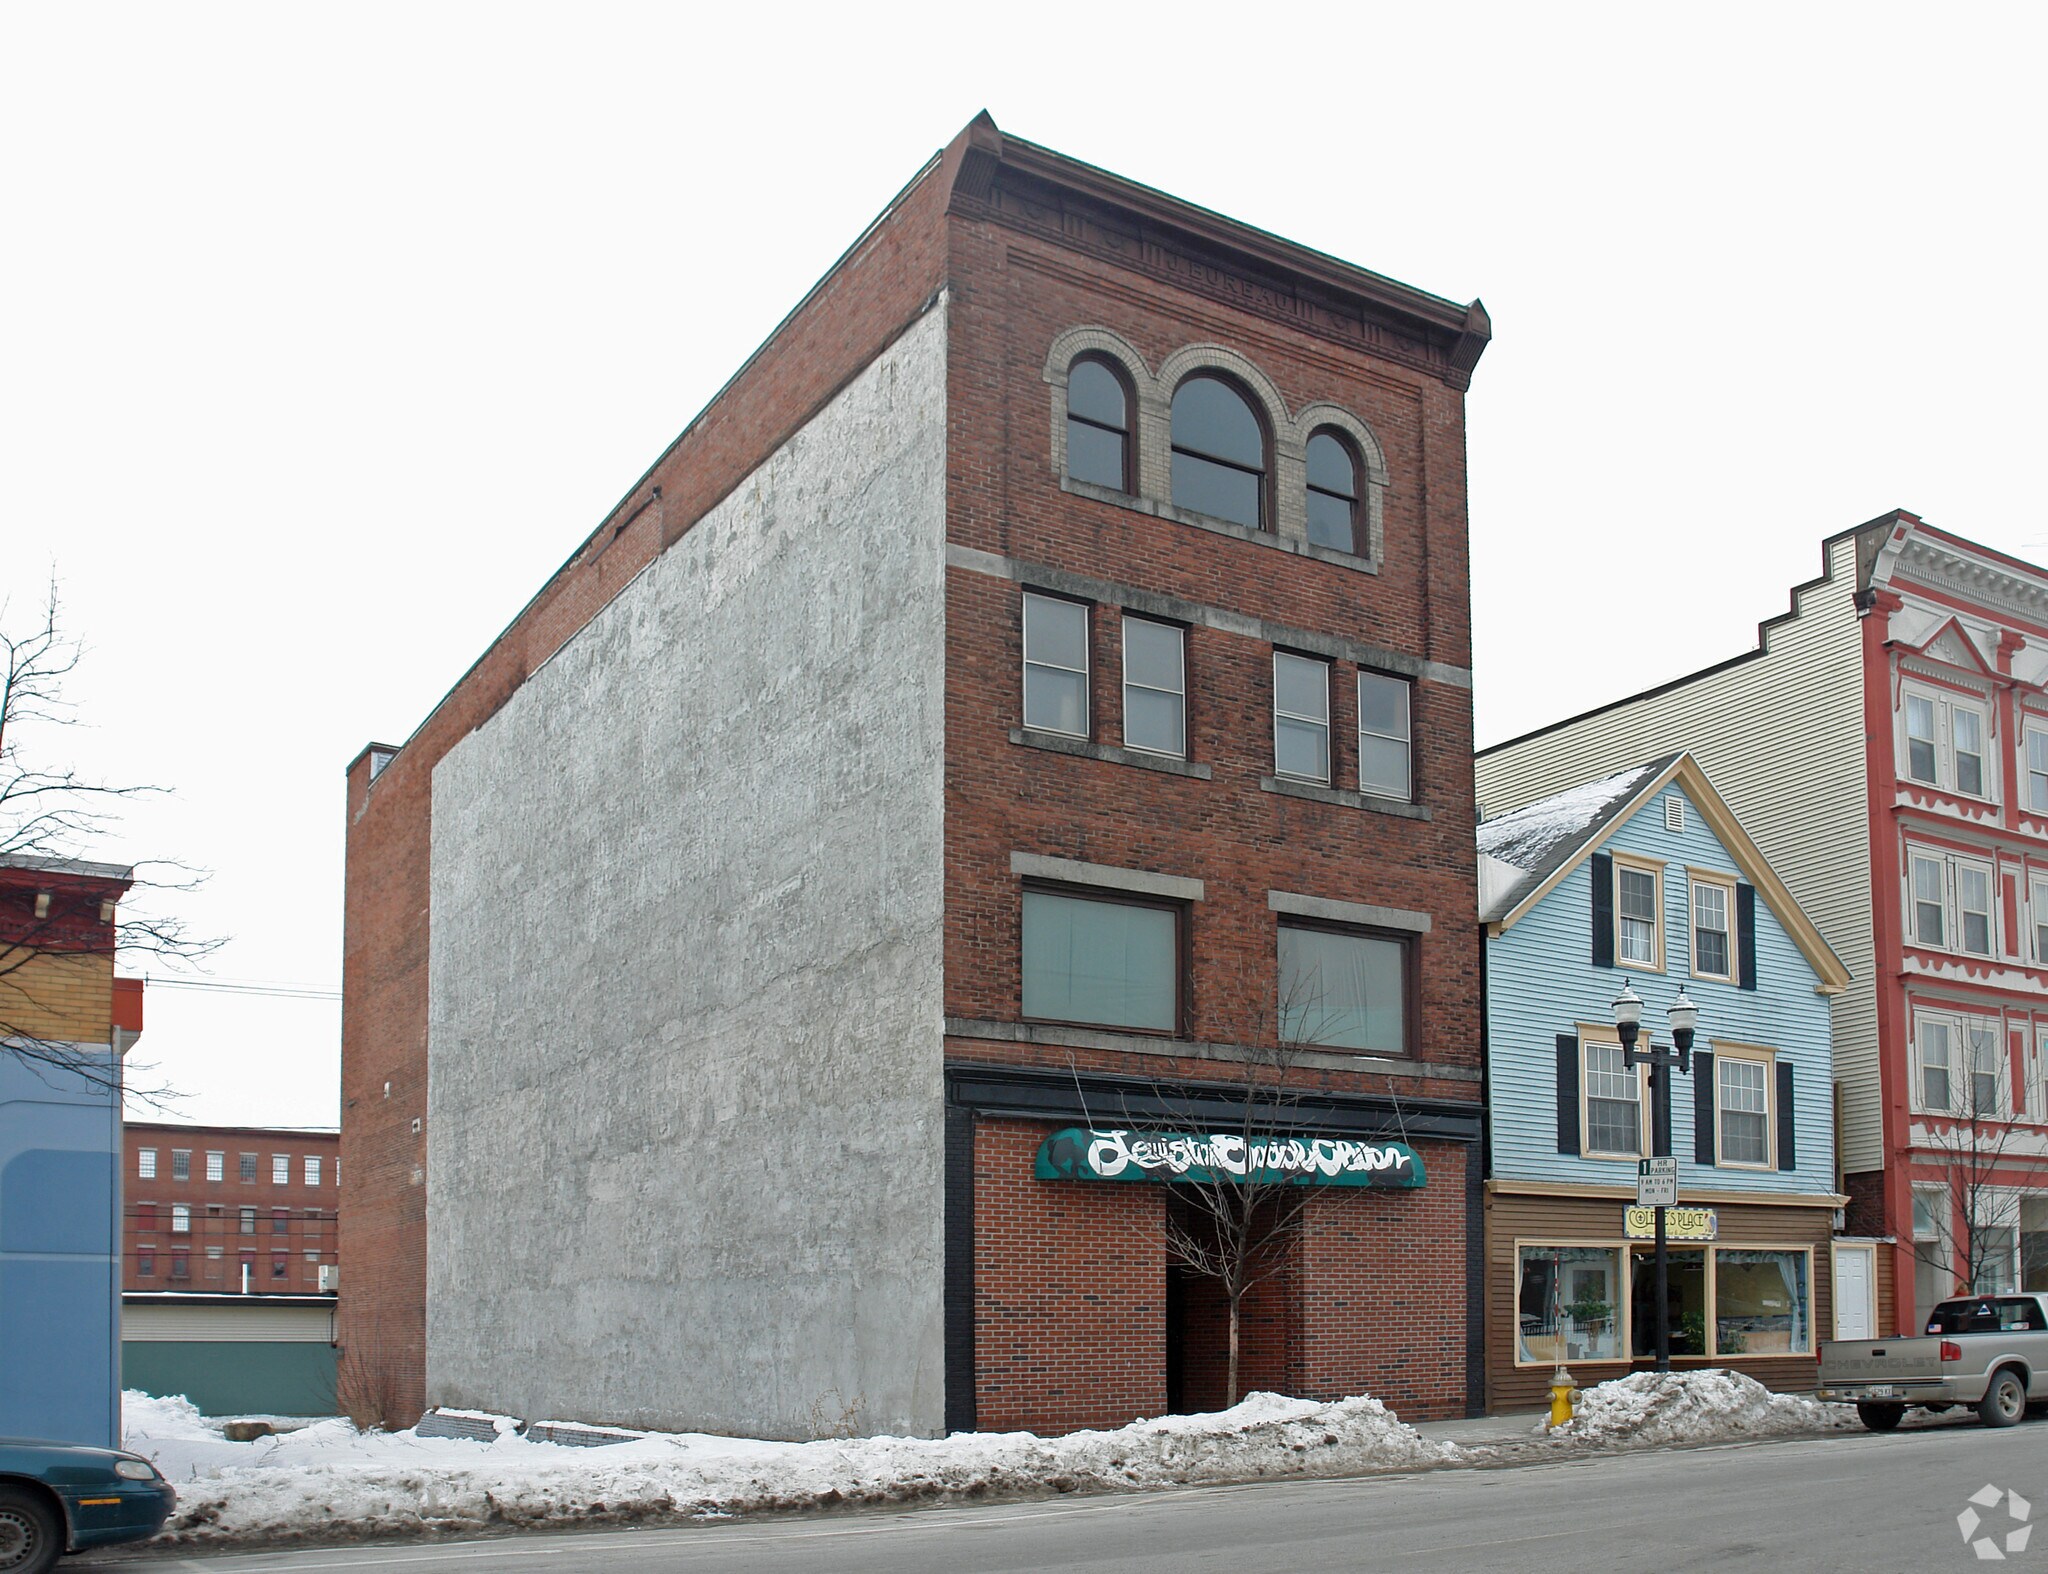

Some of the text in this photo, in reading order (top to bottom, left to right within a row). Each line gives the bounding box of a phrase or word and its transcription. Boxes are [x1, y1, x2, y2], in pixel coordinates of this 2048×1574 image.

[1642, 1161, 1648, 1175] 1
[1677, 1211, 1704, 1230] PLACE
[1824, 1356, 1938, 1370] CHEVROLET
